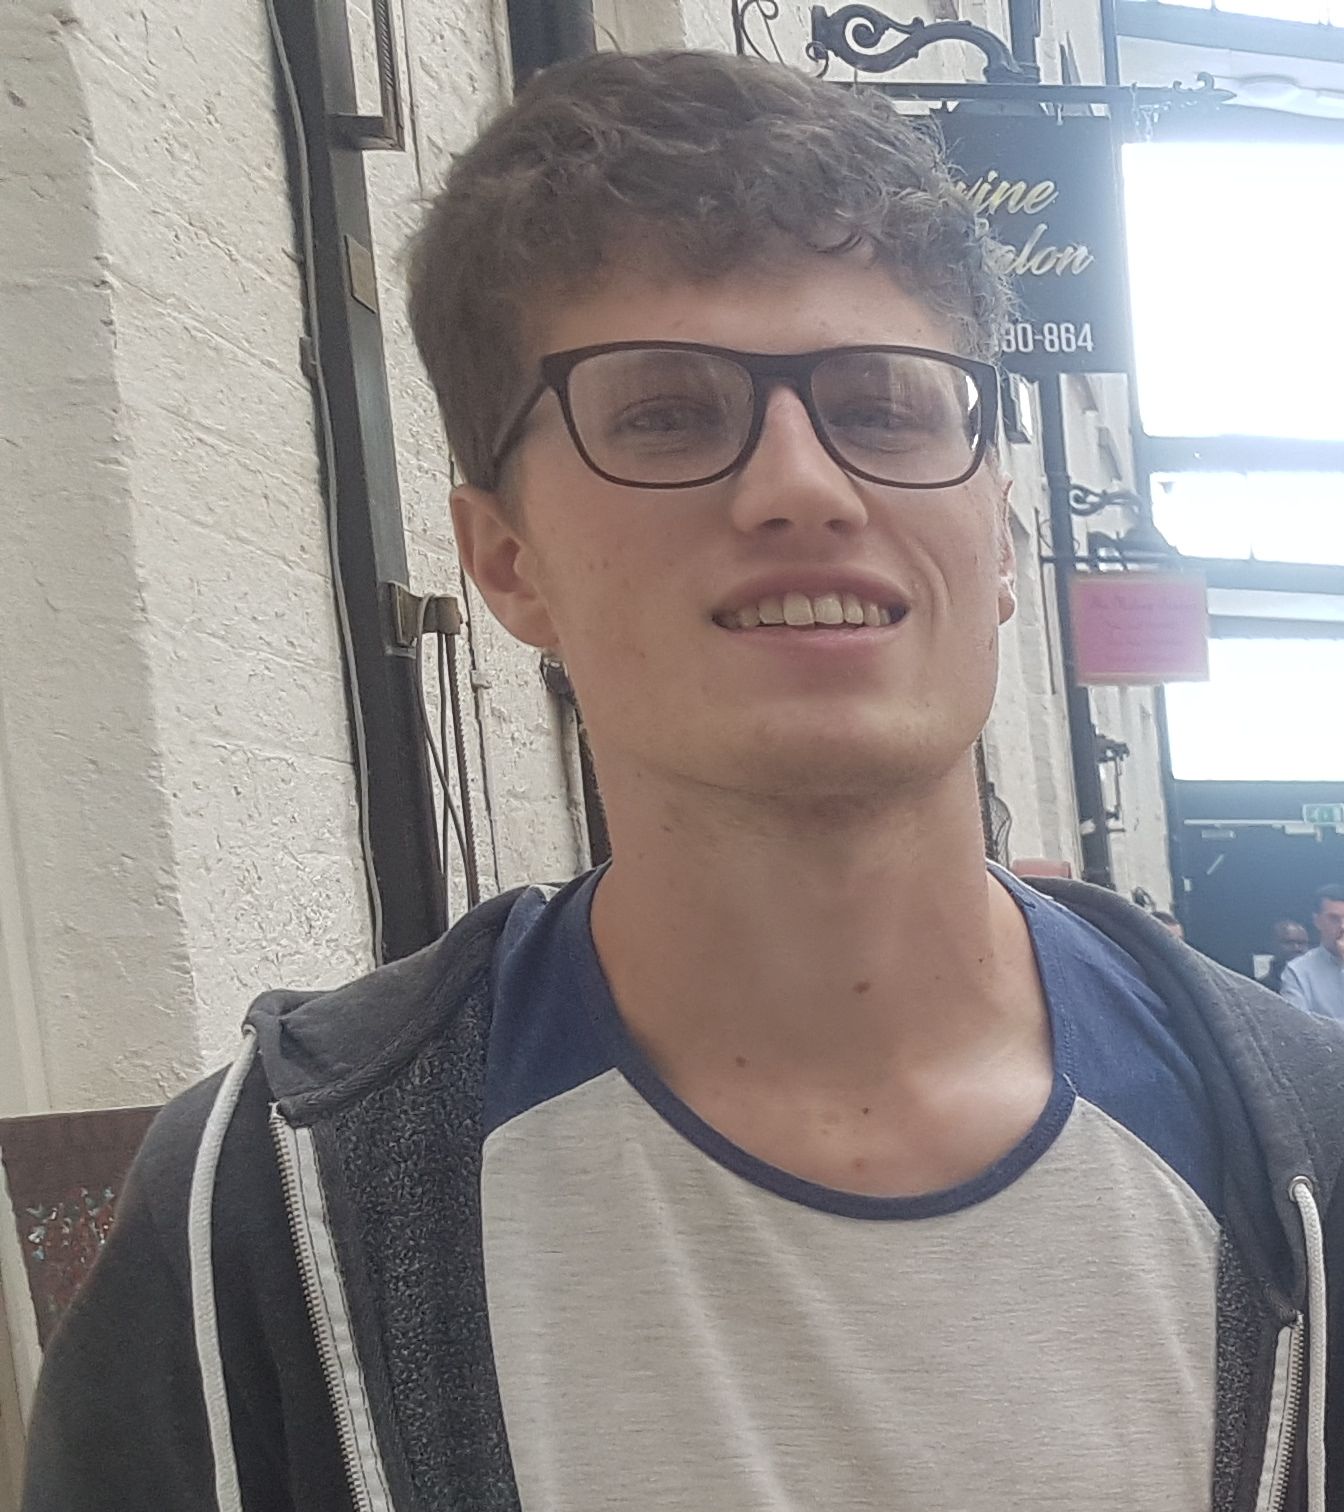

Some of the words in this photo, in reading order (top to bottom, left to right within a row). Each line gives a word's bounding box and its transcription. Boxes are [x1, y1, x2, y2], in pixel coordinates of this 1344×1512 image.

[956, 170, 1059, 214] vine
[975, 218, 1095, 277] alon
[997, 322, 1094, 353] 30-864
